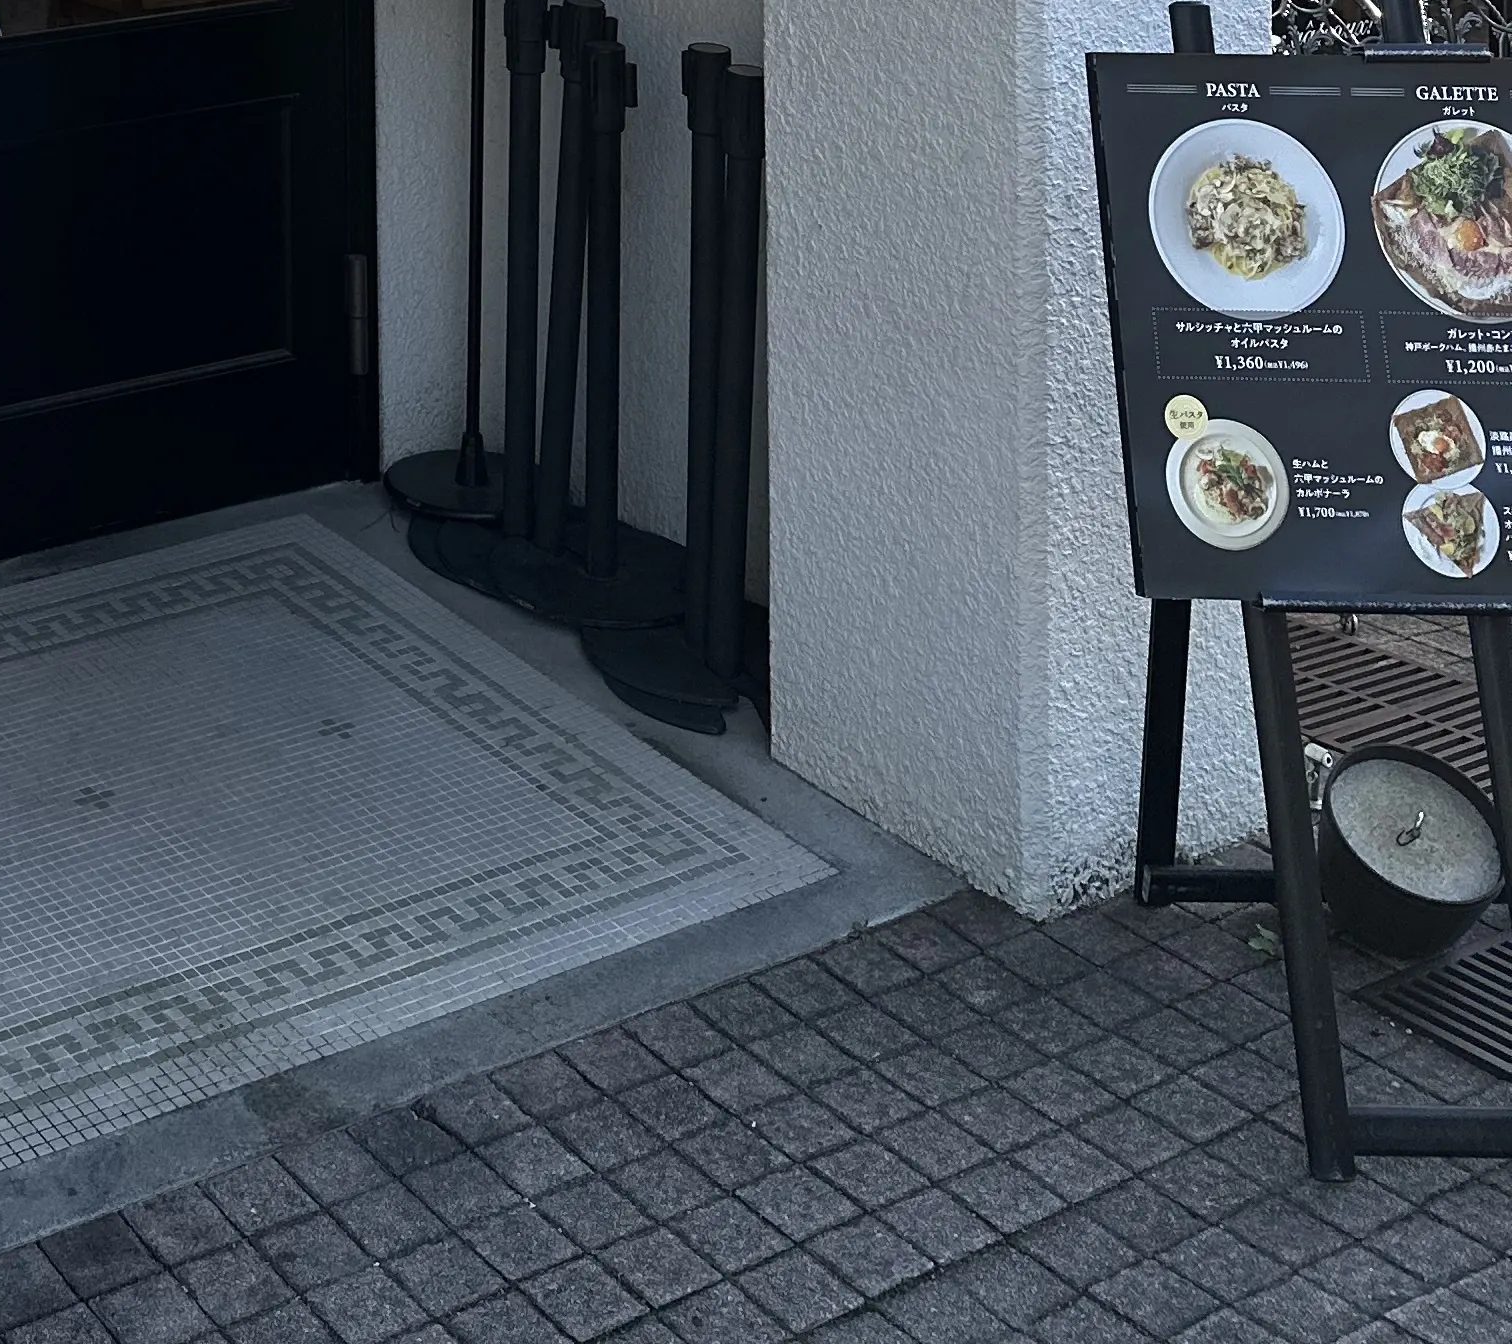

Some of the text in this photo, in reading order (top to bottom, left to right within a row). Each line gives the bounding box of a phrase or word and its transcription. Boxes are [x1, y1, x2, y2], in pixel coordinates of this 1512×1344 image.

[1205, 82, 1261, 99] PASTA
[1416, 85, 1500, 102] GALETTE
[1221, 102, 1248, 113] パスタ
[1442, 105, 1476, 117] ガレット
[1175, 321, 1343, 335] サルシッチャと六甲マッシュルームの
[1447, 328, 1512, 340] ガレット・コン
[1230, 337, 1289, 350] オイルパスタ
[1214, 355, 1264, 371] ¥1,360
[1445, 359, 1495, 375] ¥1,200
[1292, 458, 1329, 470] 生ハムと
[1294, 473, 1384, 485] 六甲マッシュルームの
[1296, 488, 1351, 500] カルボナーラ
[1297, 506, 1336, 519] ¥1,700
